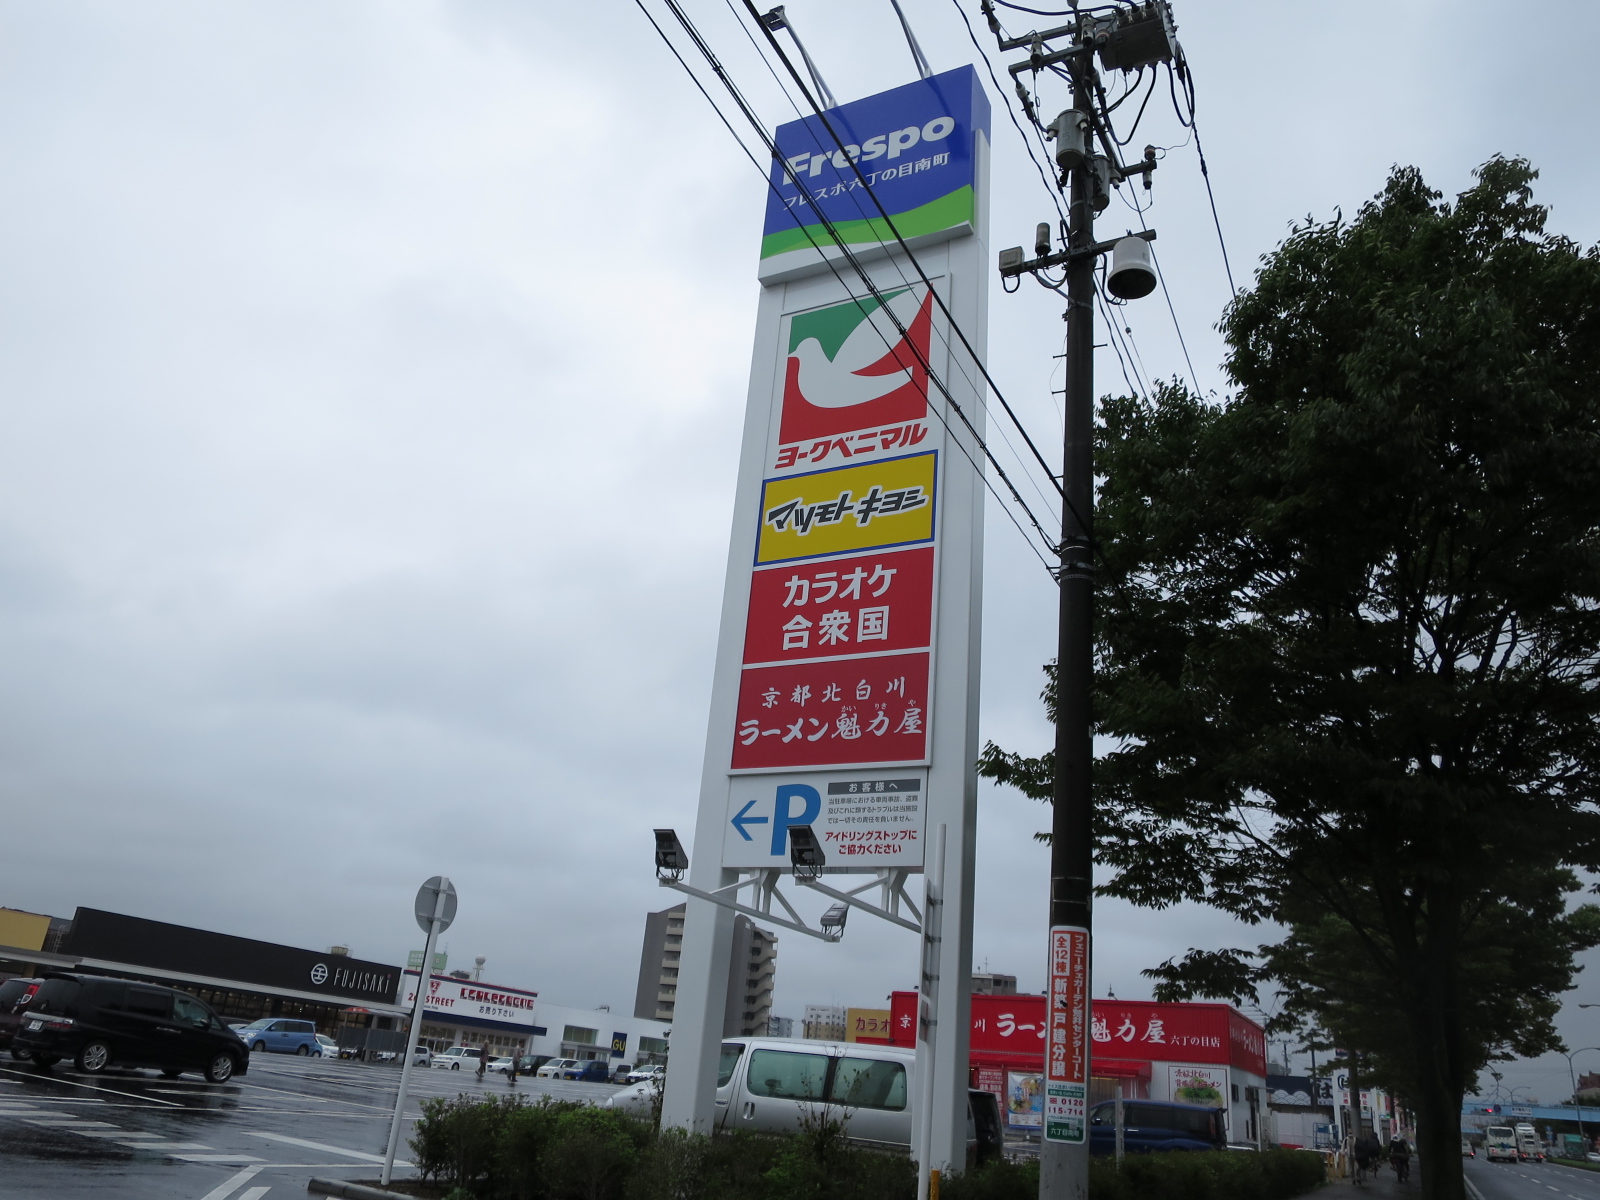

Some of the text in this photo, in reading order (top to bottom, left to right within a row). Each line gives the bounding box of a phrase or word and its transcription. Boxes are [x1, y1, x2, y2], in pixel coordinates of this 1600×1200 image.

[782, 116, 955, 186] Frespo
[783, 152, 951, 211] フレスポ六丁の目南町
[774, 422, 929, 469] ヨークベニマル
[766, 487, 928, 534] マツモトキヨシ
[782, 564, 897, 608] カラオケ
[782, 605, 890, 650] 合衆国
[761, 676, 905, 708] 京都北白川
[848, 782, 898, 793] お客様へ
[771, 784, 821, 856] P
[825, 830, 918, 842] アイドリングストップに
[838, 844, 902, 855] ご協力ください
[425, 996, 455, 1008] STREET
[479, 1006, 514, 1017] お売り下さい
[612, 1039, 626, 1052] GU
[1170, 1036, 1221, 1048] 六丁の目店
[1061, 1098, 1084, 1107] 0120
